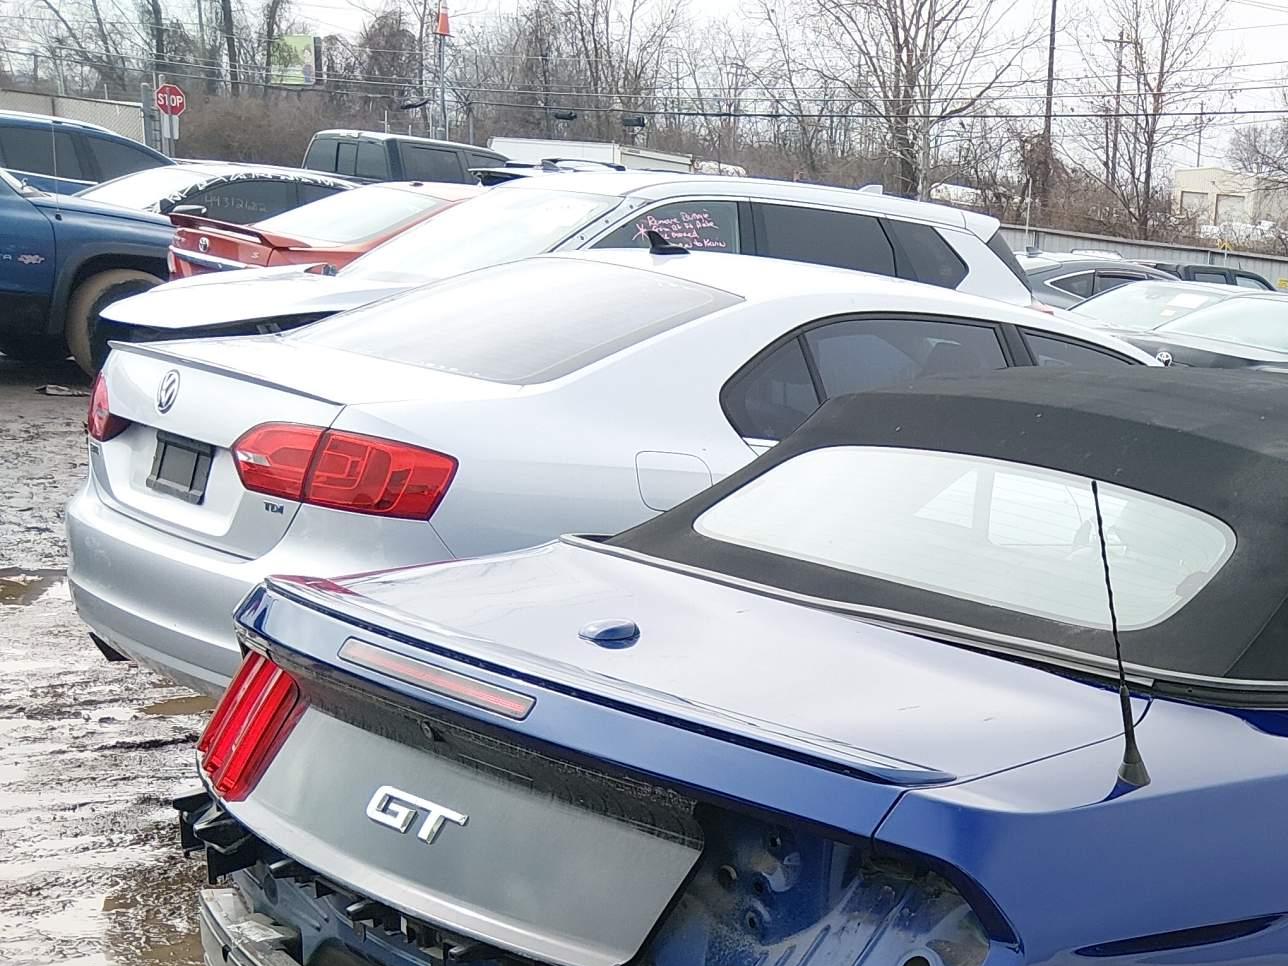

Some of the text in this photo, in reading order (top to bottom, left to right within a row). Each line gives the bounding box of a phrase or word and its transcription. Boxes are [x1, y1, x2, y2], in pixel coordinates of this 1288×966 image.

[158, 93, 183, 107] STOP
[263, 500, 285, 515] TDI
[366, 784, 470, 845] GT
